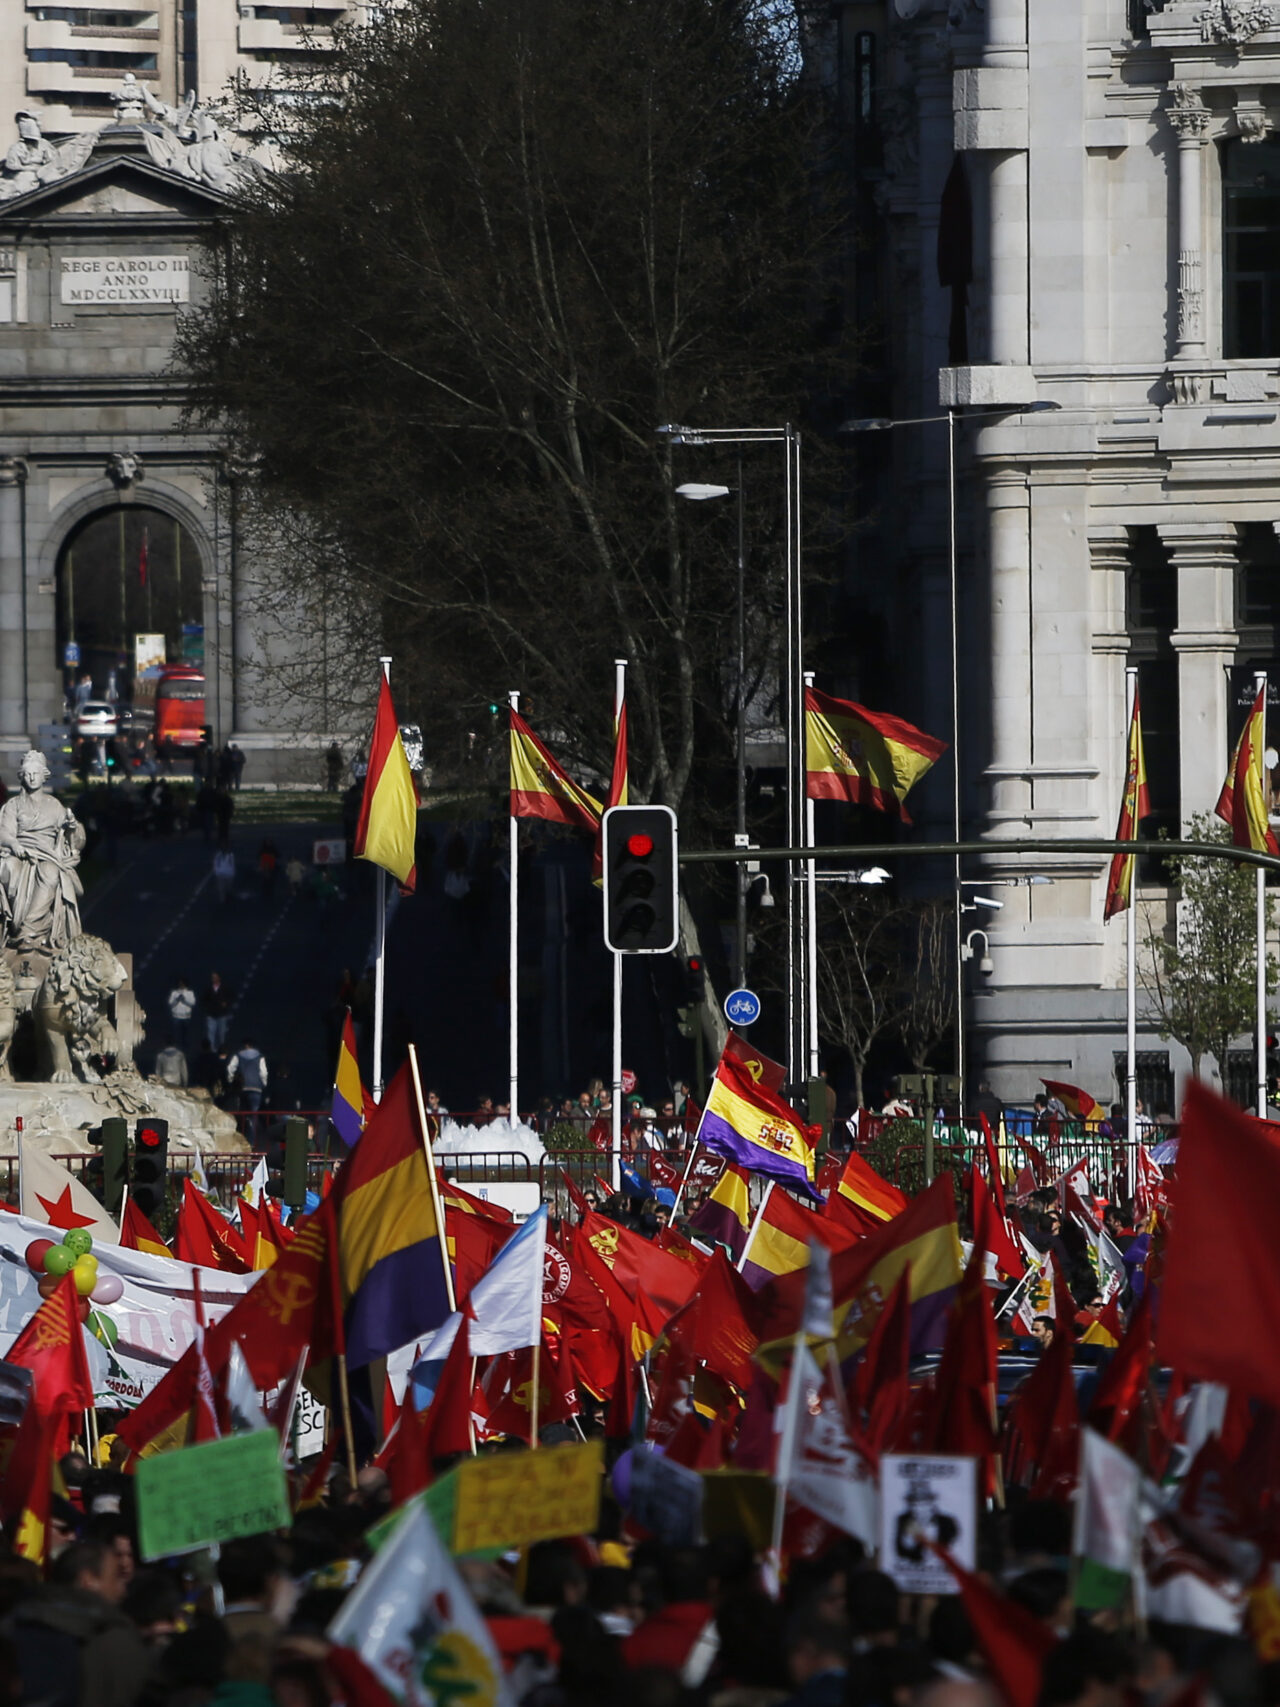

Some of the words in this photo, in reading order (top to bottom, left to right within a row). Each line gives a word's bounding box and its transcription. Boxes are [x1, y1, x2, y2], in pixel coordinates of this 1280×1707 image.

[61, 261, 101, 273] REGE
[106, 260, 167, 272] CAROLO
[172, 260, 188, 272] III
[102, 275, 149, 286] ANNO
[70, 288, 180, 300] MDCCLXXVIII
